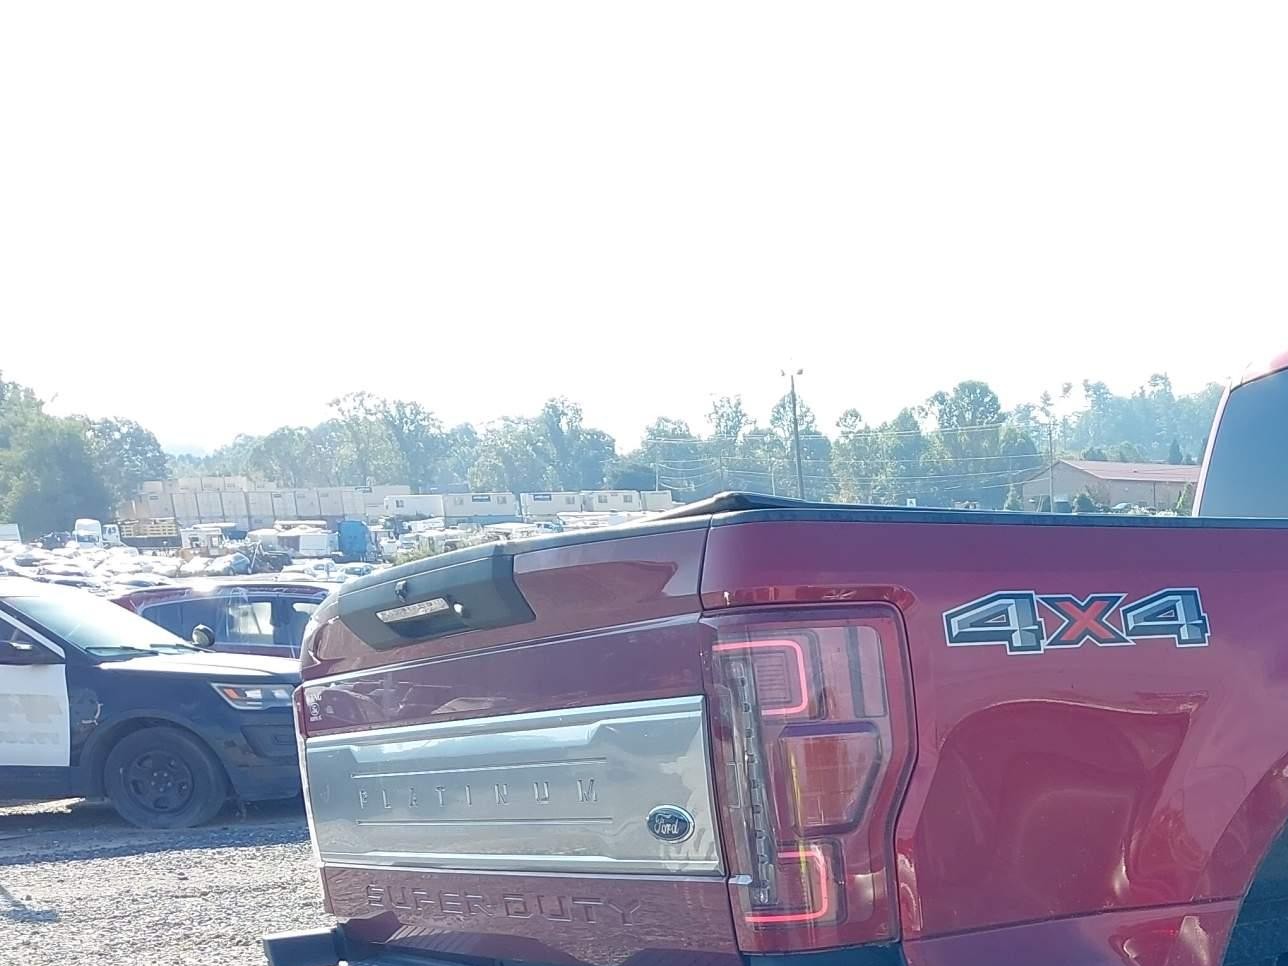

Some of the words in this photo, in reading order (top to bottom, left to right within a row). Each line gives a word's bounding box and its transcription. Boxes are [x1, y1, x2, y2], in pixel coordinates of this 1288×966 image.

[358, 778, 599, 810] PLATINUM
[653, 813, 680, 835] Ford
[366, 883, 494, 917] SUPER
[502, 893, 641, 927] DUTY
